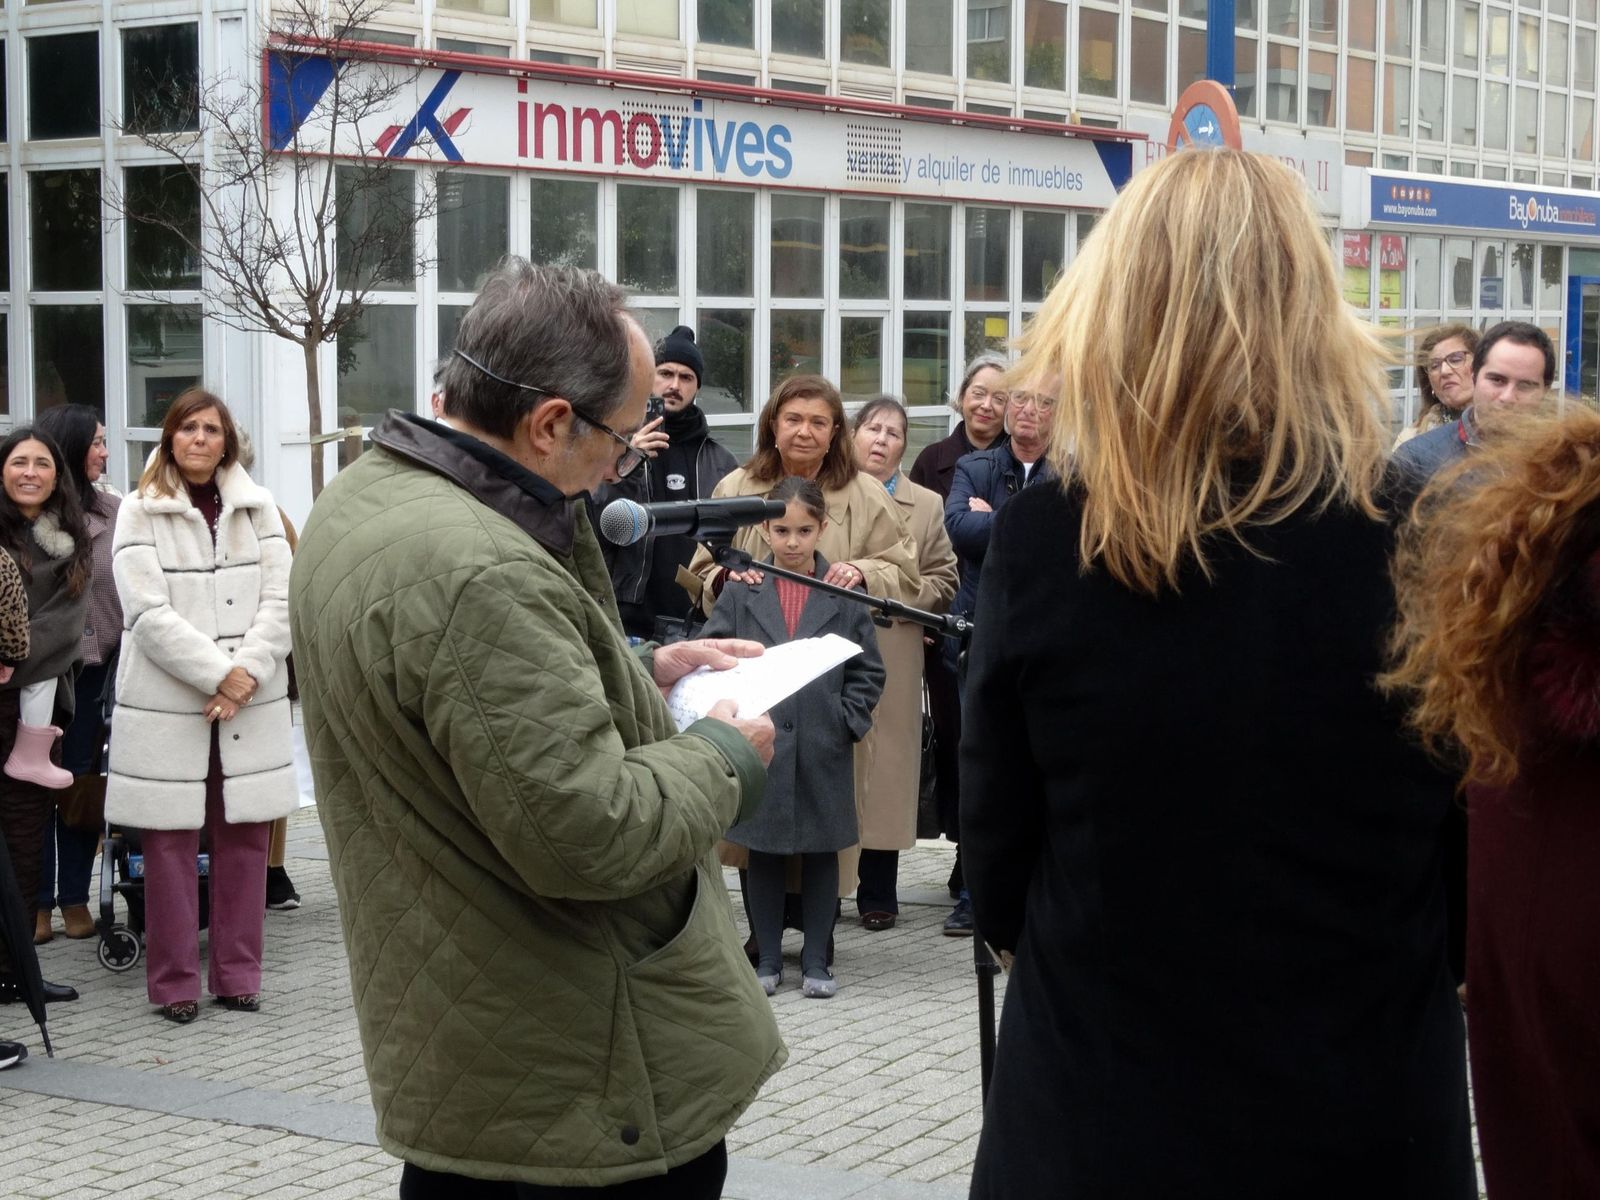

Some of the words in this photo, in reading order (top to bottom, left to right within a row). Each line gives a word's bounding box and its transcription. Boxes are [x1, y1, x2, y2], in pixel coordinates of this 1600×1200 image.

[516, 80, 792, 179] inmovives
[847, 151, 897, 174] venta
[902, 158, 912, 183] y
[918, 153, 975, 187] alquiler
[981, 159, 1001, 183] de
[1008, 160, 1083, 191] inmuebles
[1317, 160, 1329, 192] II
[1383, 203, 1437, 217] www.bayonuba.com
